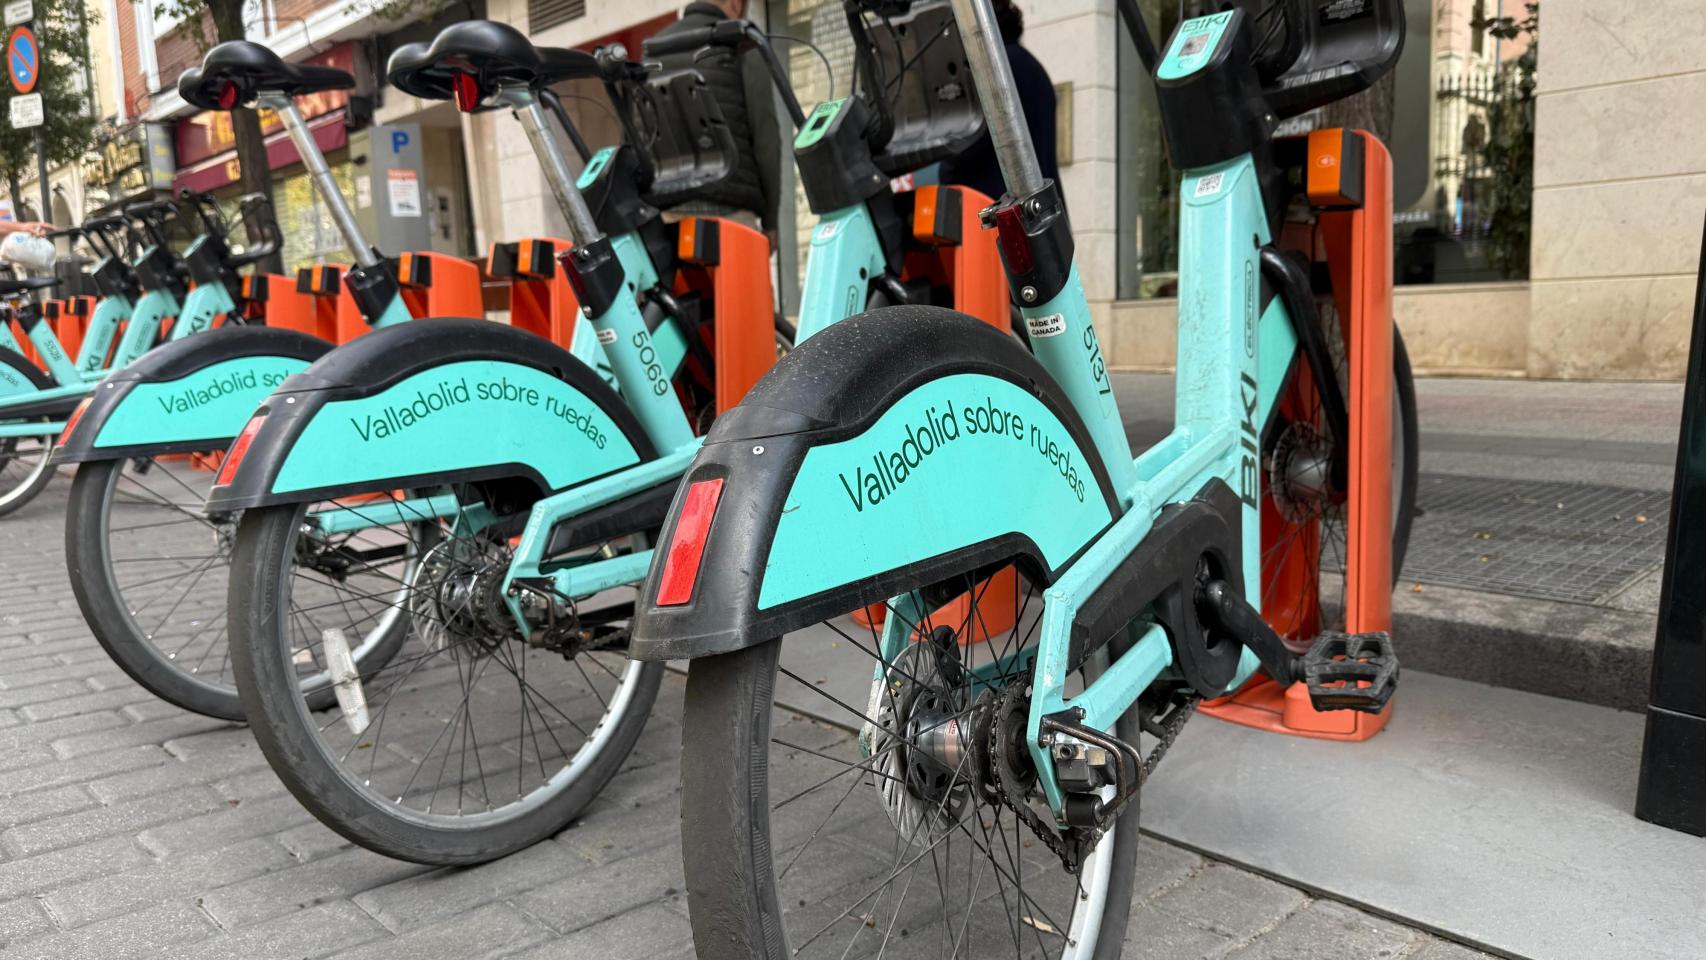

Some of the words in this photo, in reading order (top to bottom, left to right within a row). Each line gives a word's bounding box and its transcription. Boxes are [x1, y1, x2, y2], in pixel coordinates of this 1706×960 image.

[1182, 14, 1230, 32] BIKI
[391, 131, 410, 154] P
[1029, 319, 1049, 328] MADE
[1050, 317, 1060, 325] IN
[1031, 325, 1061, 336] CANADA
[632, 330, 669, 397] 5069
[1083, 324, 1111, 395] 5137
[157, 369, 257, 415] Valladolid
[350, 377, 471, 442] Valladolid
[476, 377, 540, 406] sobre
[545, 394, 608, 450] ruedas
[838, 399, 961, 513] Valladolid
[963, 396, 1025, 441] sobre
[1029, 423, 1085, 504] ruedas
[1240, 371, 1258, 511] BIKI
